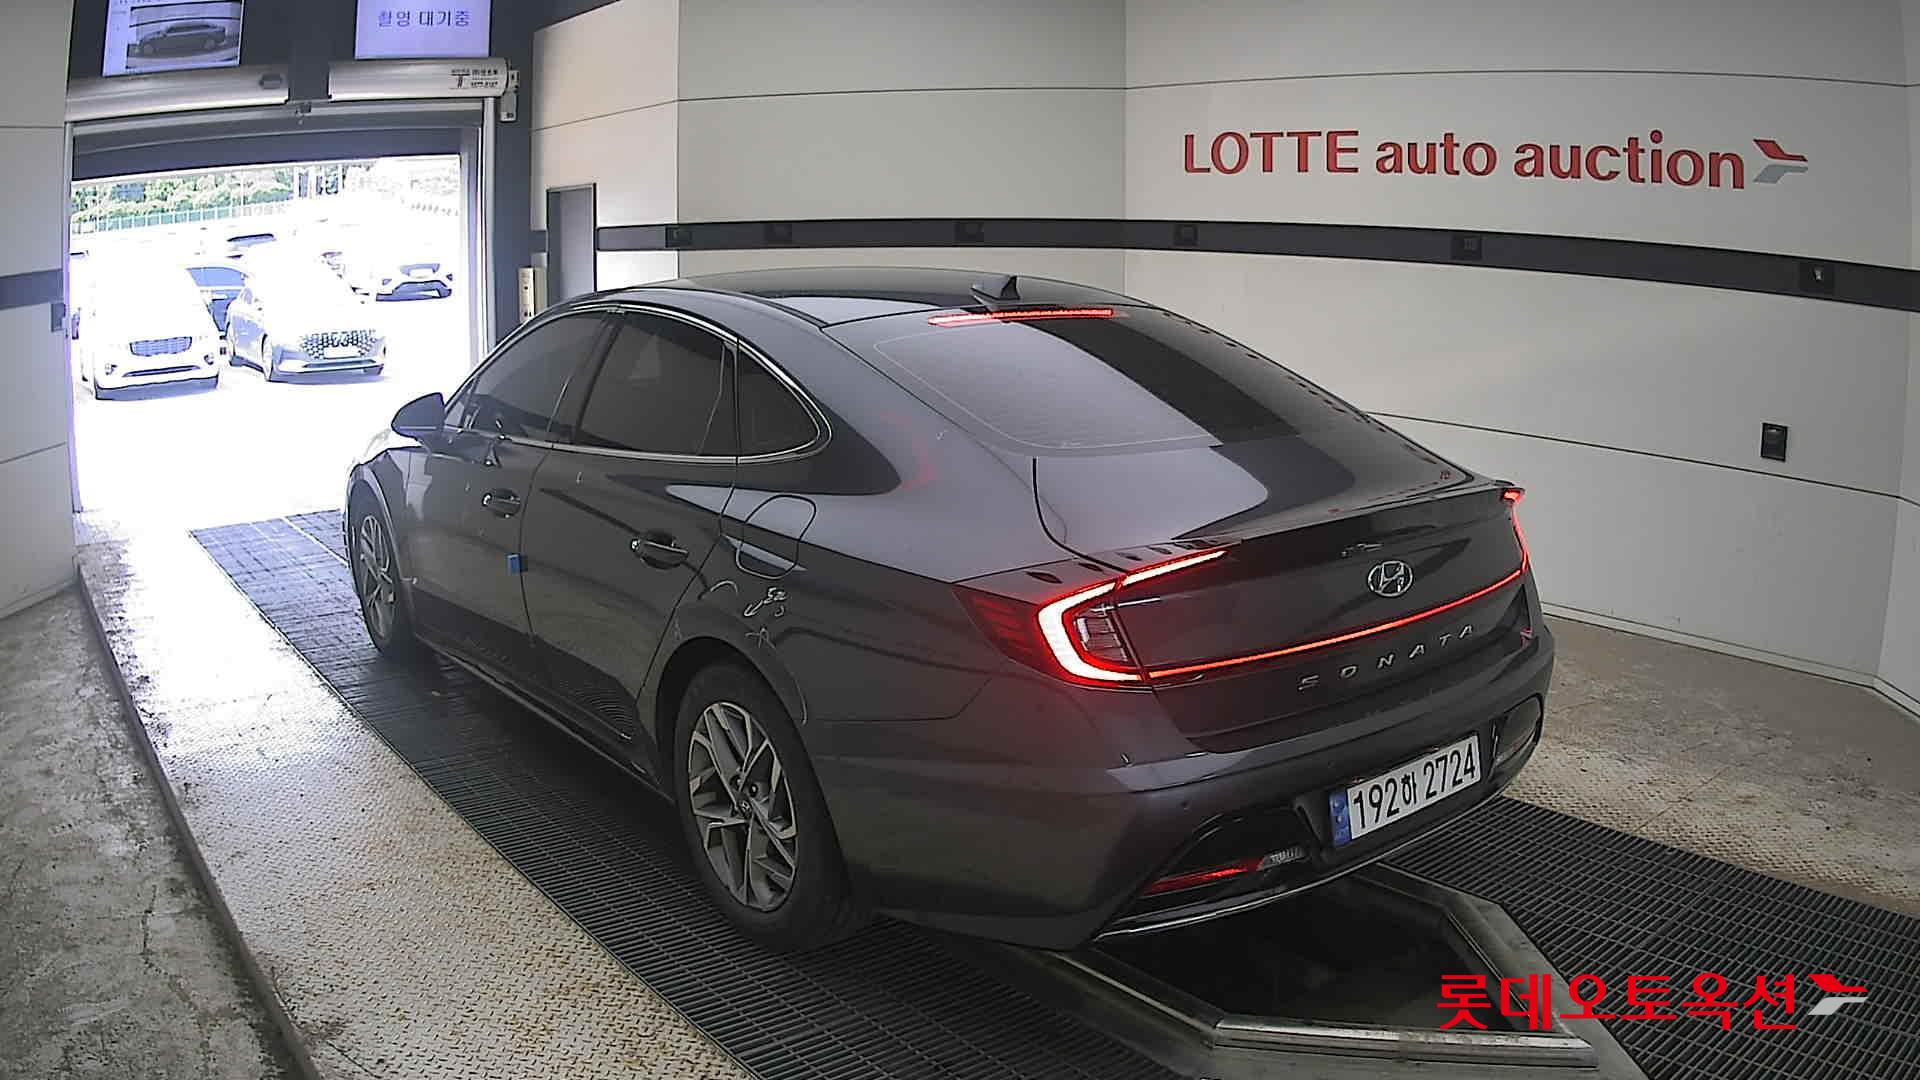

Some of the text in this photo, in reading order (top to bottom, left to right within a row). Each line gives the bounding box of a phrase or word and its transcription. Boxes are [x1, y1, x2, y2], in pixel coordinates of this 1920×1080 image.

[419, 10, 469, 27] 대기중
[1184, 130, 1744, 189] LOTTE auto auction
[1298, 624, 1473, 691] SONATA
[1353, 742, 1476, 829] 192하 2724
